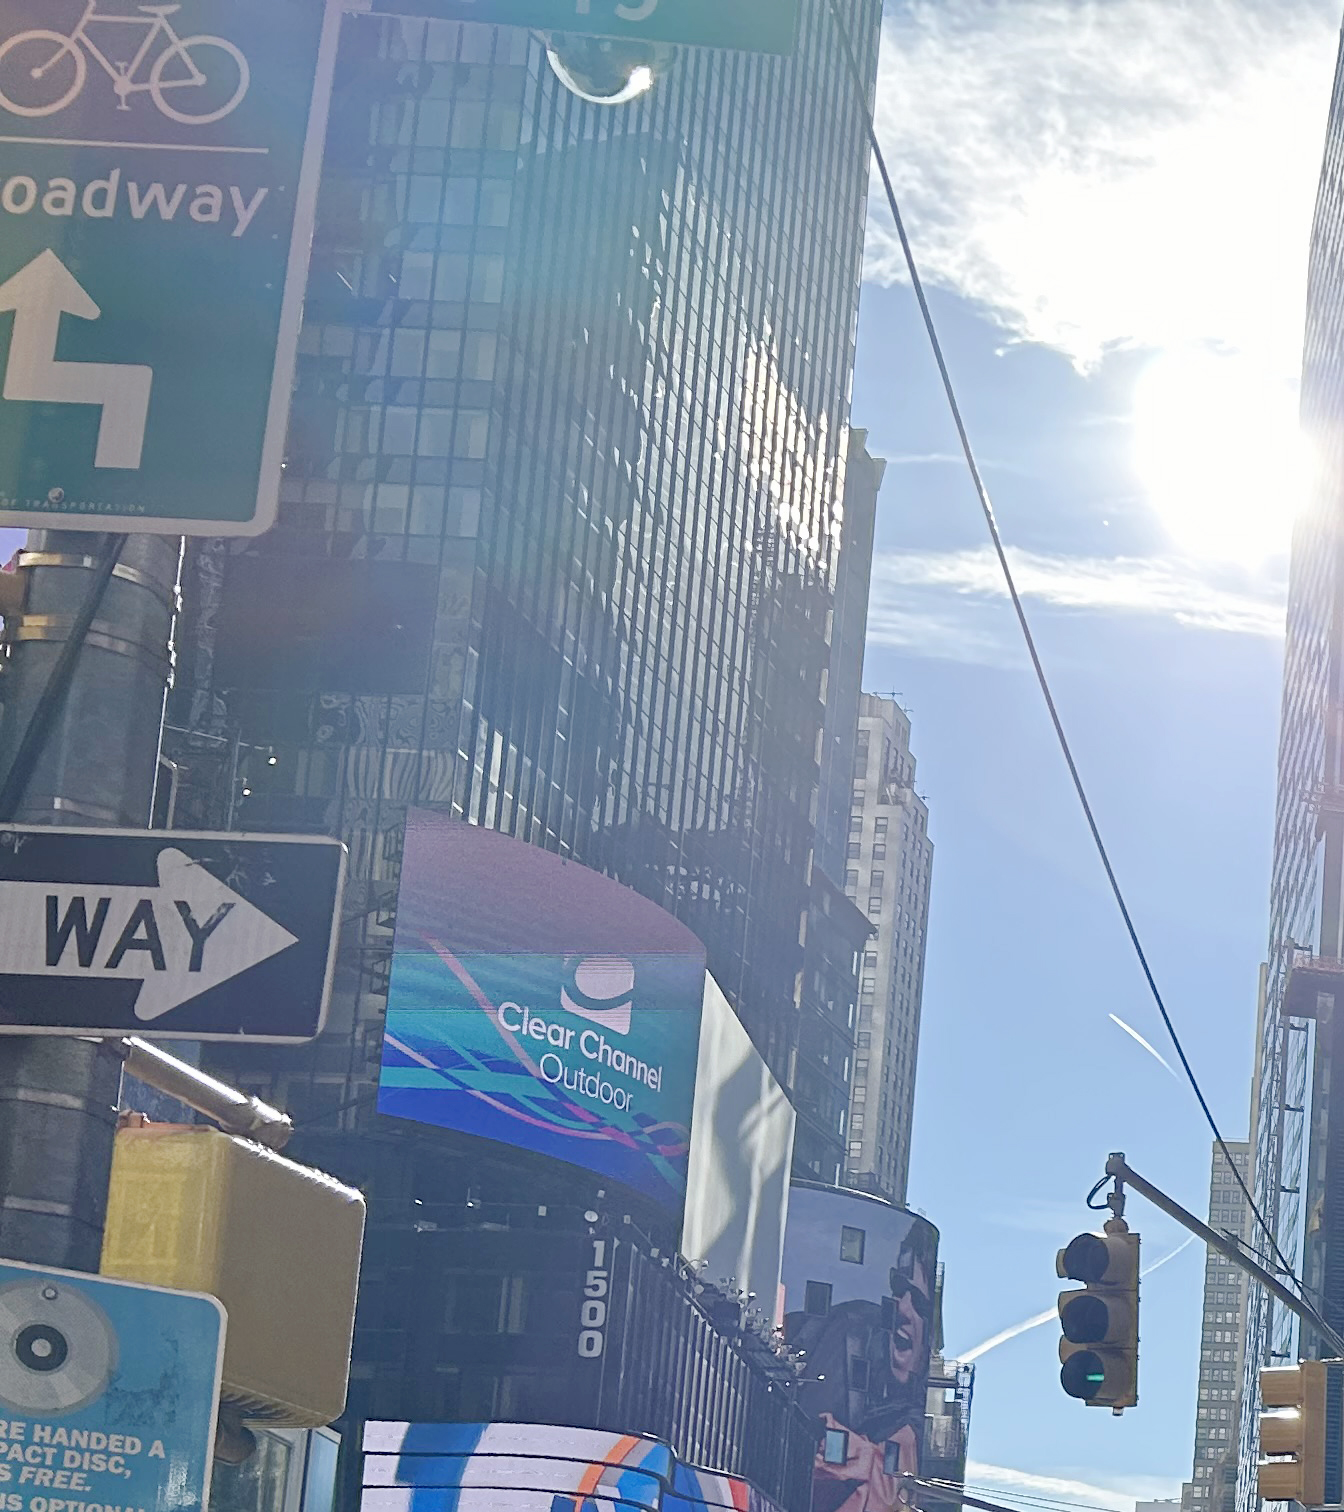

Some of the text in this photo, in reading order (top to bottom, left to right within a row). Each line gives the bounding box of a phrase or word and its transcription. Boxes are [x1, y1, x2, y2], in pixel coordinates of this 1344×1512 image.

[45, 894, 236, 973] WAY
[497, 1001, 663, 1093] Clear Channel
[539, 1052, 634, 1113] Outdoor
[577, 1240, 609, 1358] 1500
[33, 1424, 142, 1455] HANDED
[148, 1440, 166, 1459] A
[63, 1450, 132, 1479] DISC,
[18, 1466, 92, 1491] FREE.
